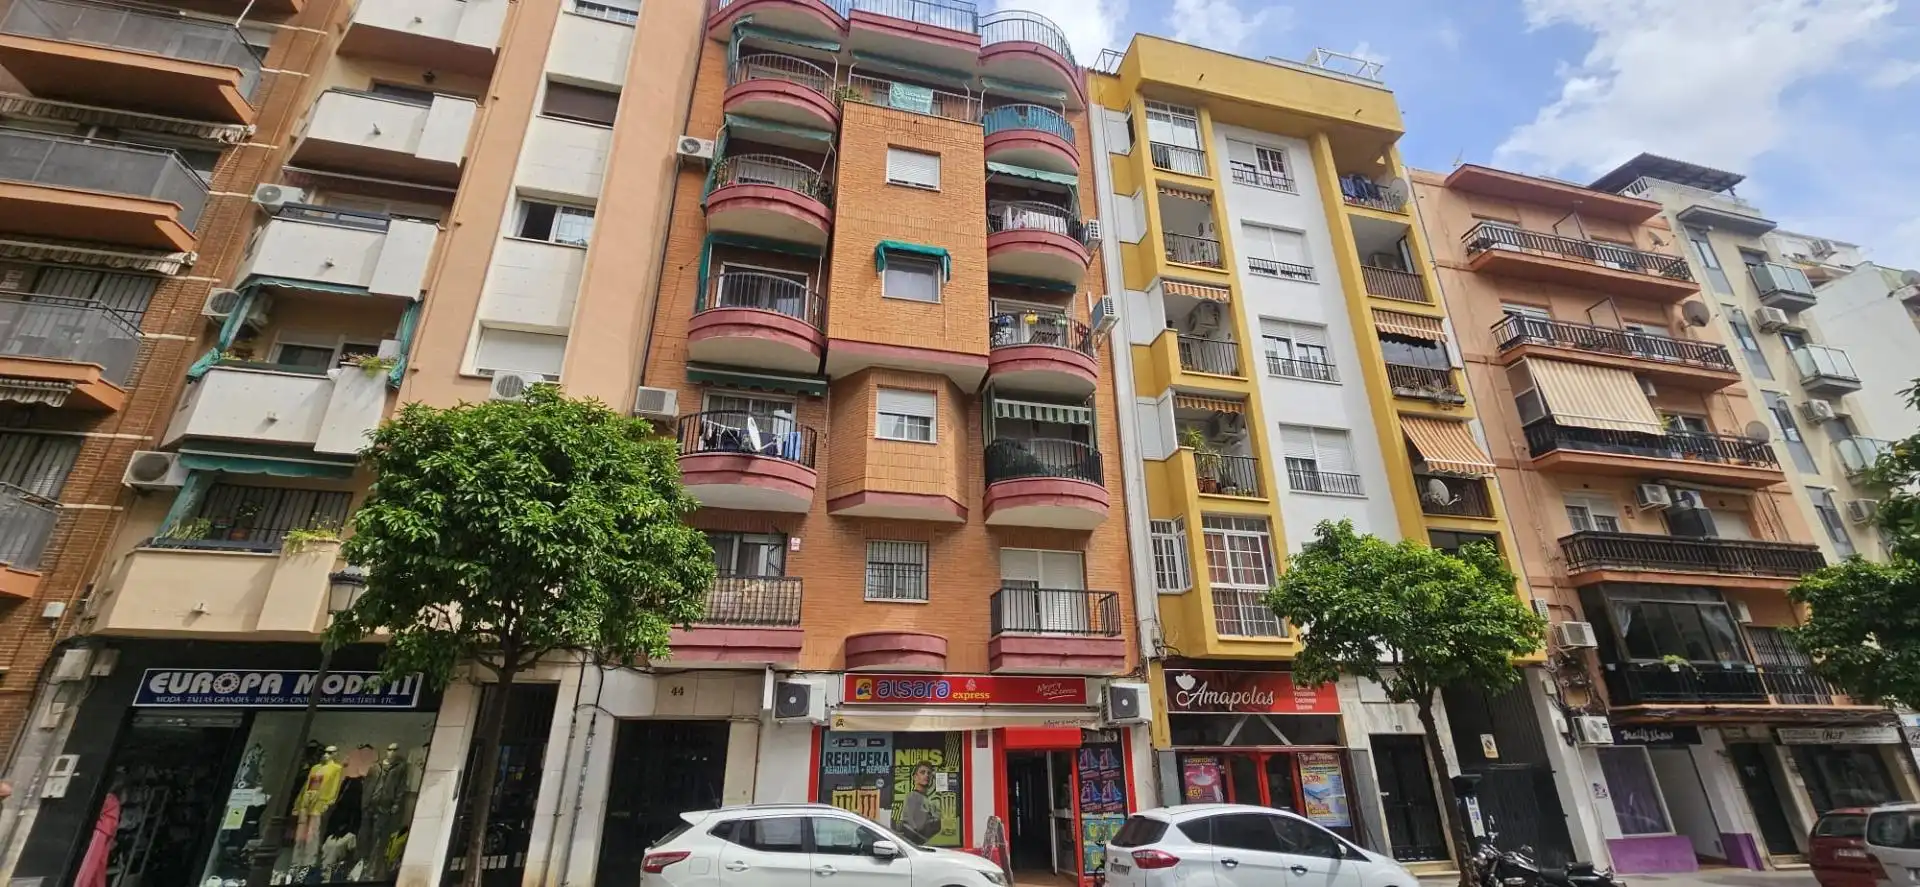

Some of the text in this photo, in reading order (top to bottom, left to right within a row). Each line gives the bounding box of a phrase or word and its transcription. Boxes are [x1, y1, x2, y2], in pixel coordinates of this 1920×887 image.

[149, 672, 284, 695] EUROPA
[671, 686, 684, 696] 44
[877, 679, 990, 701] alsara express
[156, 696, 181, 704] MODA
[1176, 680, 1274, 711] Amapolas
[826, 751, 890, 766] RECUPERA
